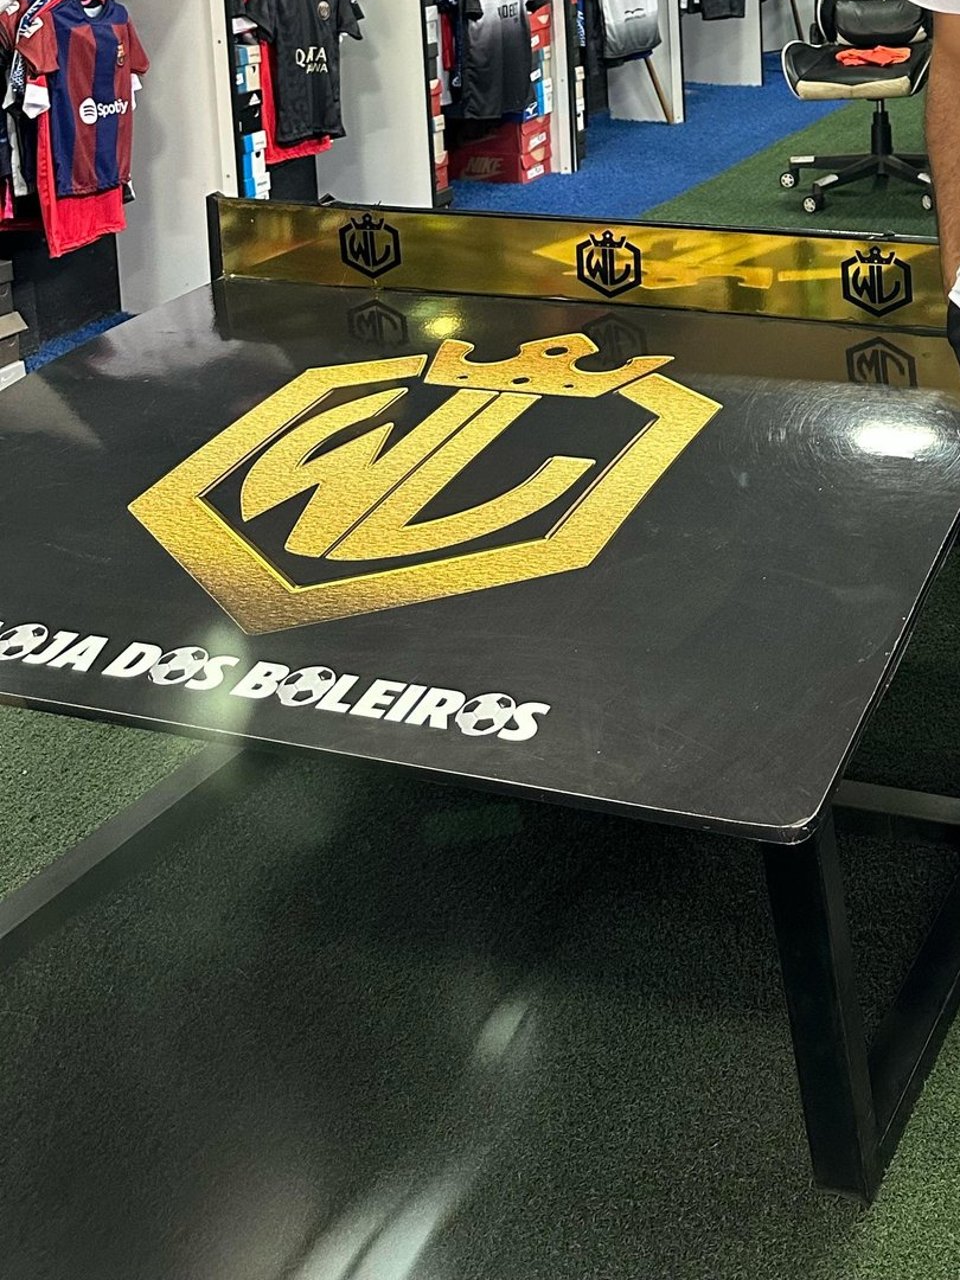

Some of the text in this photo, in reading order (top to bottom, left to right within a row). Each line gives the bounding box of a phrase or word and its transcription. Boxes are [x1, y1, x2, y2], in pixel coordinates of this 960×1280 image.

[97, 98, 129, 118] Spotiy
[465, 157, 504, 174] NIKE
[0, 621, 552, 742] OJA DOS BOLEIROS
